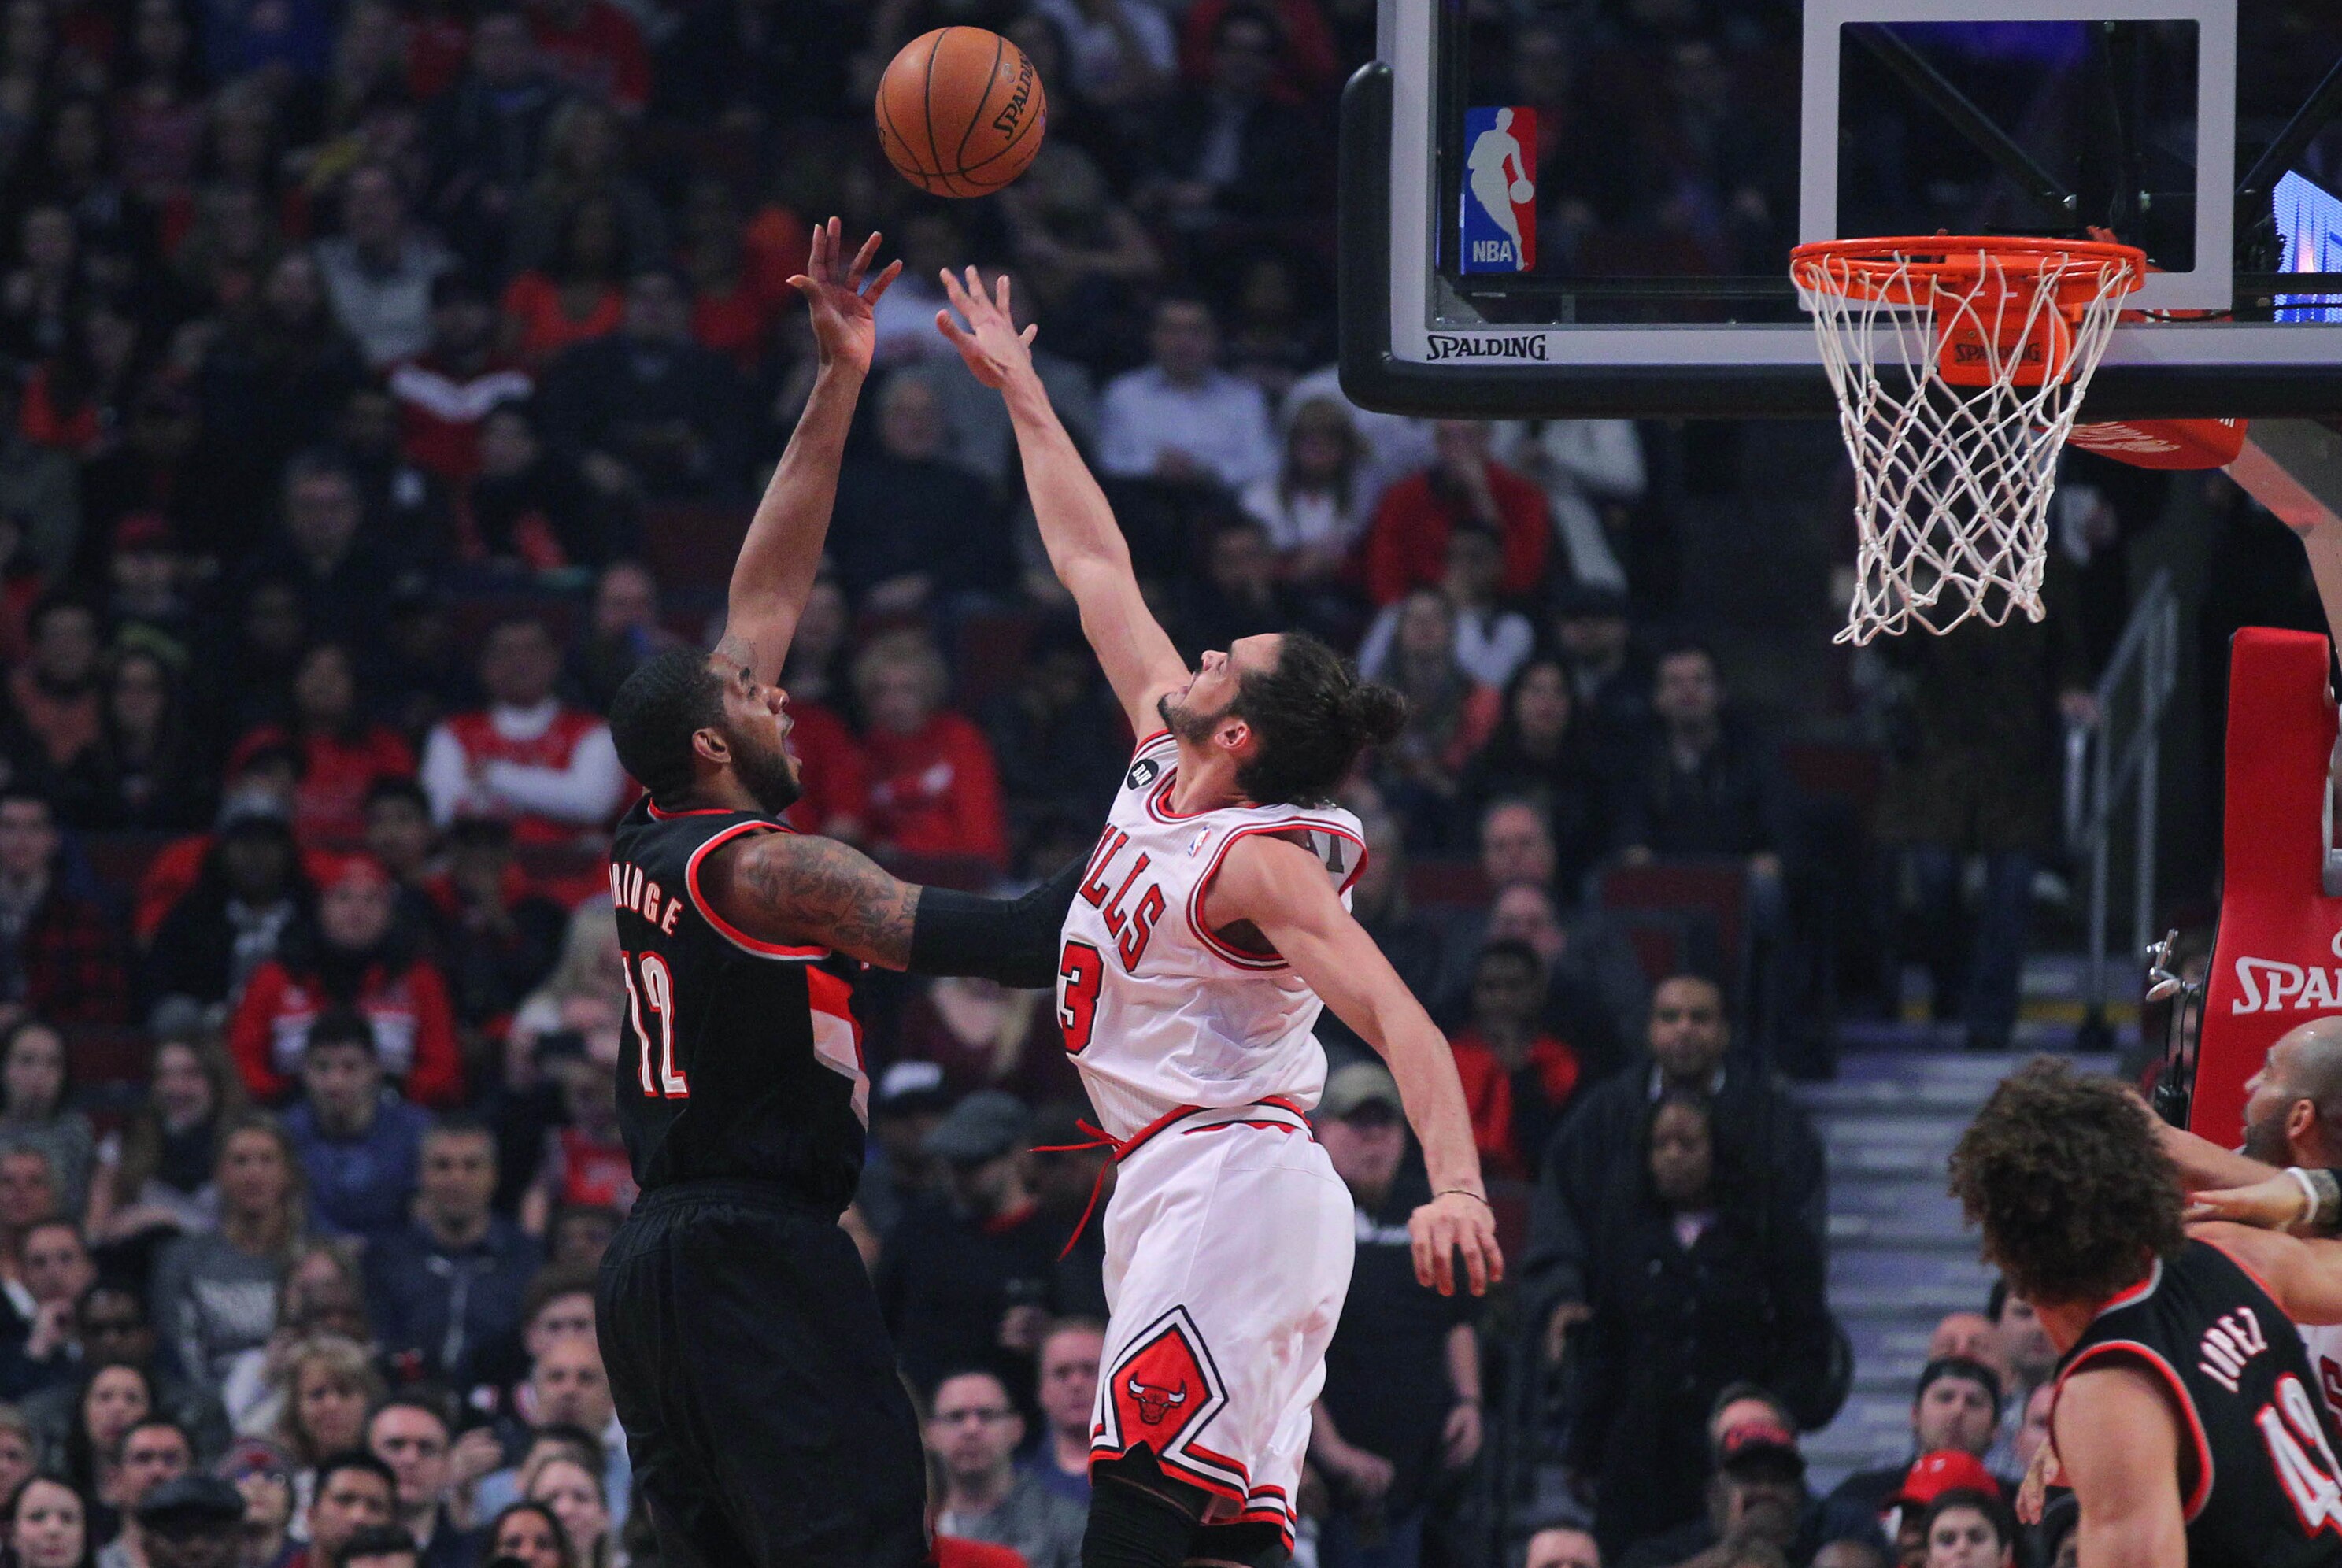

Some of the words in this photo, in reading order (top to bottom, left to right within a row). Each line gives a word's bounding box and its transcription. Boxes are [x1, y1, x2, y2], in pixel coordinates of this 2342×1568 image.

[1473, 240, 1513, 263] NBA
[1426, 334, 1546, 361] SPALDING
[609, 861, 684, 937] RIDGE
[620, 950, 690, 1098] 12
[2197, 1306, 2268, 1392] LOPEZ
